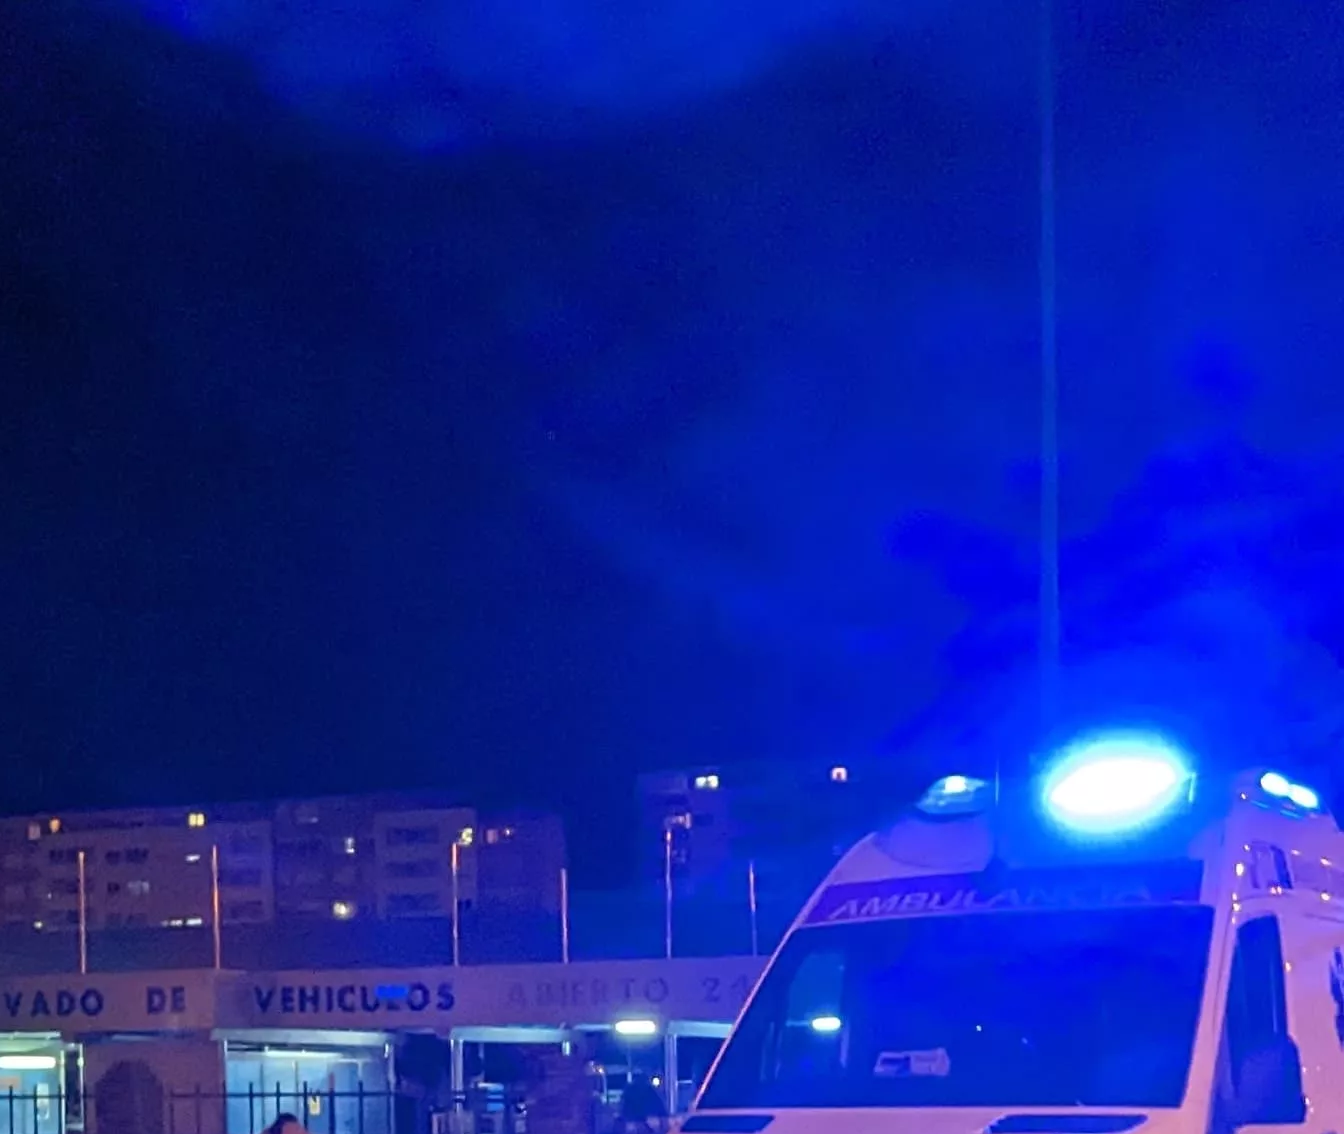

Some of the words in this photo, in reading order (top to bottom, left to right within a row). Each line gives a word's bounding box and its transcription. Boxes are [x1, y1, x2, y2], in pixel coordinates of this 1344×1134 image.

[146, 986, 185, 1014] DE
[254, 981, 455, 1013] VEHICULOS
[509, 977, 668, 1007] ABIERTO
